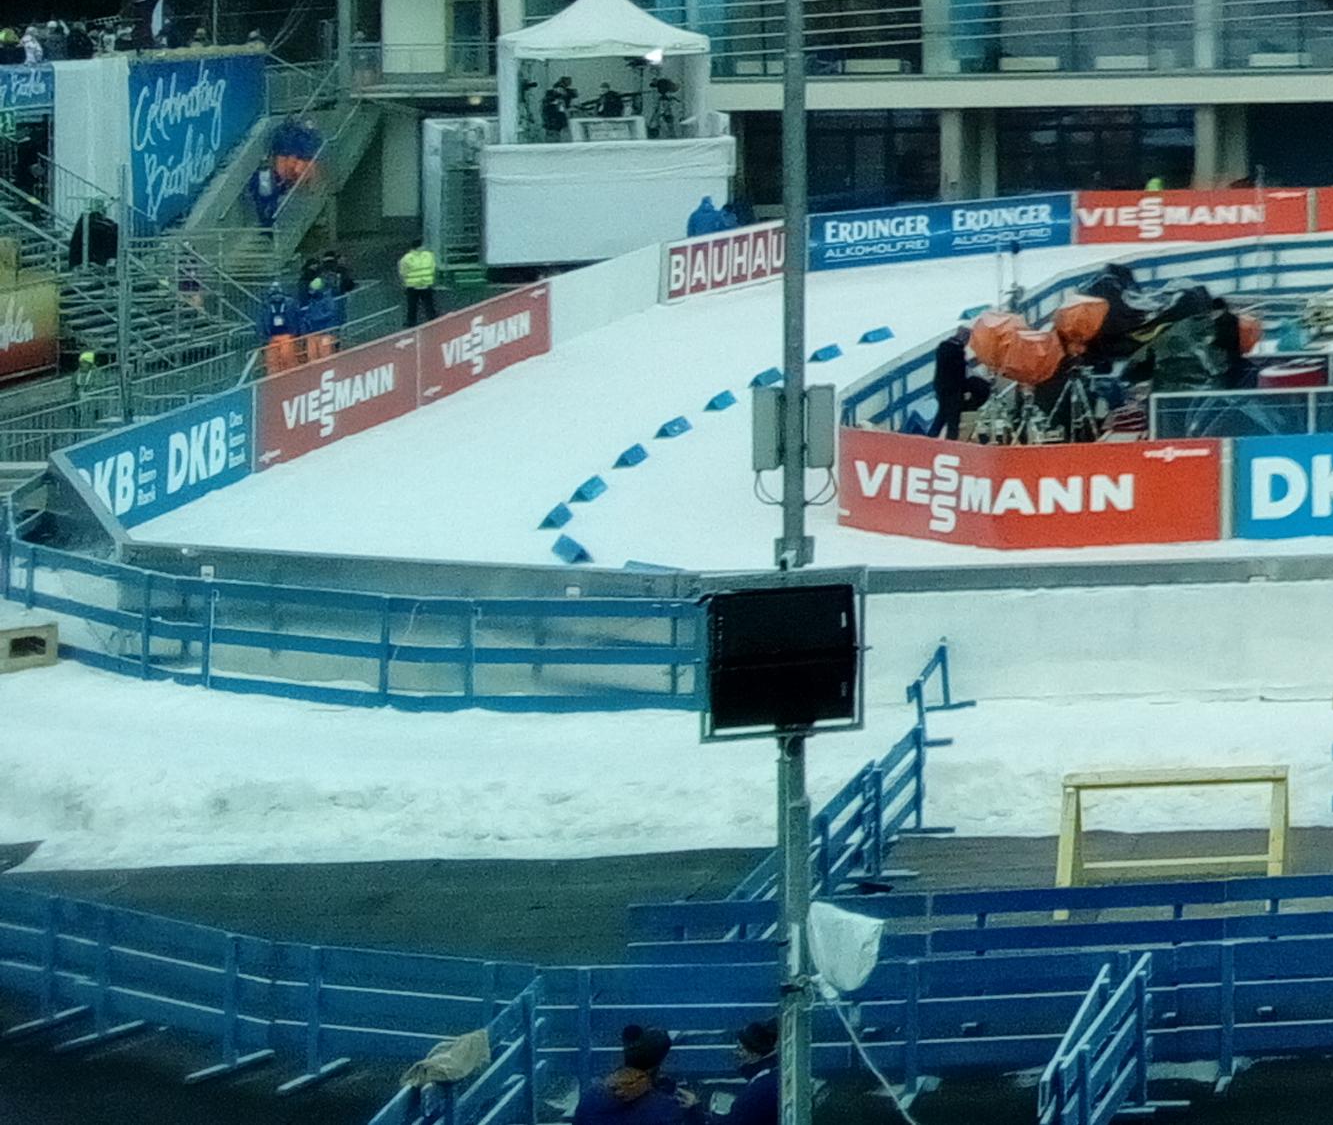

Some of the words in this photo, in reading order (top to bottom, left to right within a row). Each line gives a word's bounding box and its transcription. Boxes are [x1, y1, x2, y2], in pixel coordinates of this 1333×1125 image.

[824, 214, 930, 243] ERDINGER
[951, 228, 1051, 248] ALKOHOLFREI
[952, 204, 1052, 232] ERDINGER
[1076, 196, 1266, 239] VIESSMANN
[669, 229, 785, 290] BAUHAU
[823, 239, 930, 259] ALKOHOLFREI
[440, 309, 532, 376] VIESSMANN
[282, 362, 396, 439] VIESSMANN
[166, 416, 228, 495] DKB
[854, 453, 1136, 534] VIESSMANN
